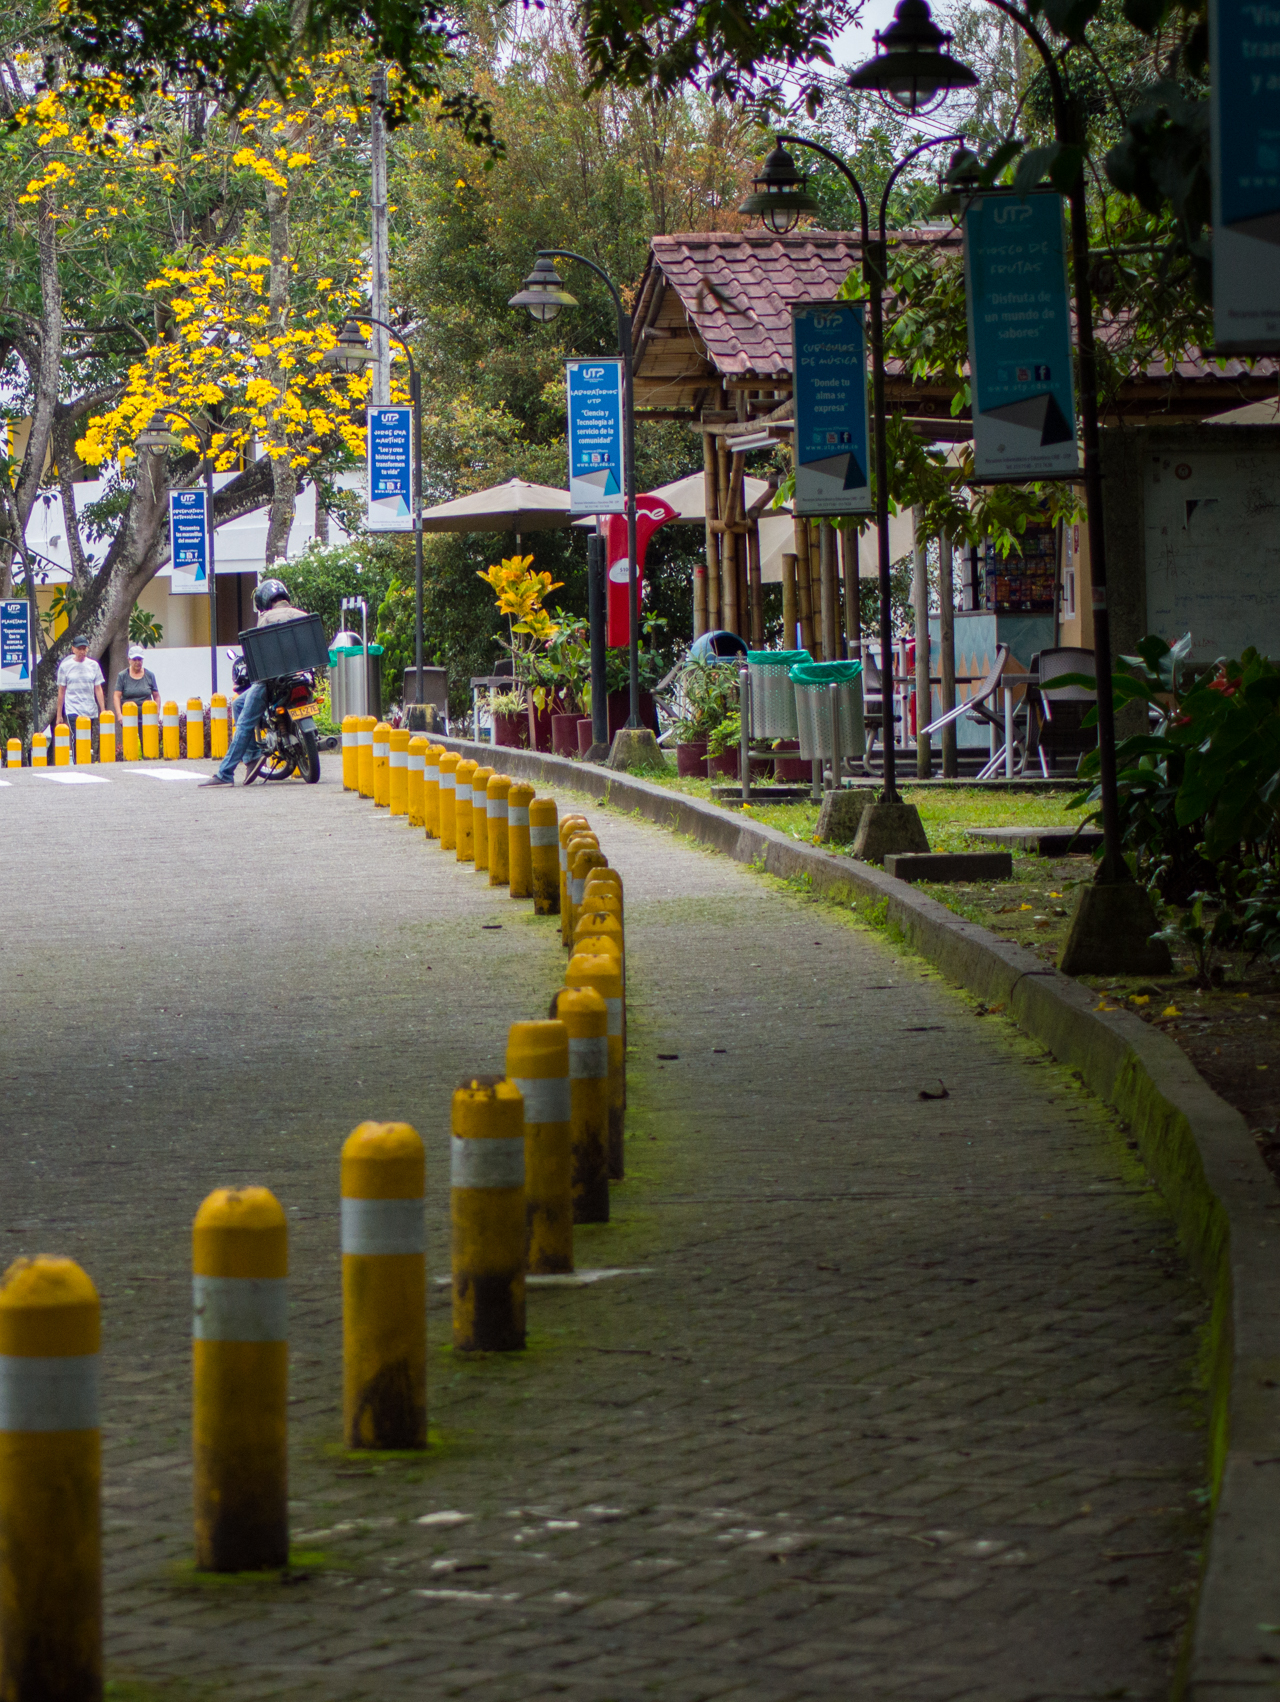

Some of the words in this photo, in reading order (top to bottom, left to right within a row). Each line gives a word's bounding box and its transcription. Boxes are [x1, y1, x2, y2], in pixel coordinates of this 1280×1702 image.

[993, 204, 1033, 224] UTP
[1029, 241, 1048, 254] DE
[991, 260, 1043, 274] FRUTAS
[1037, 291, 1051, 303] de
[985, 313, 998, 322] un
[1001, 309, 1039, 321] mundo
[1042, 307, 1055, 319] de
[814, 314, 843, 329] UTP
[801, 357, 815, 366] DE
[818, 355, 858, 365] MÚSICA
[583, 368, 604, 378] UTP
[841, 378, 850, 386] tu
[815, 391, 835, 399] alma
[381, 413, 399, 421] UTP
[180, 494, 195, 502] UTP
